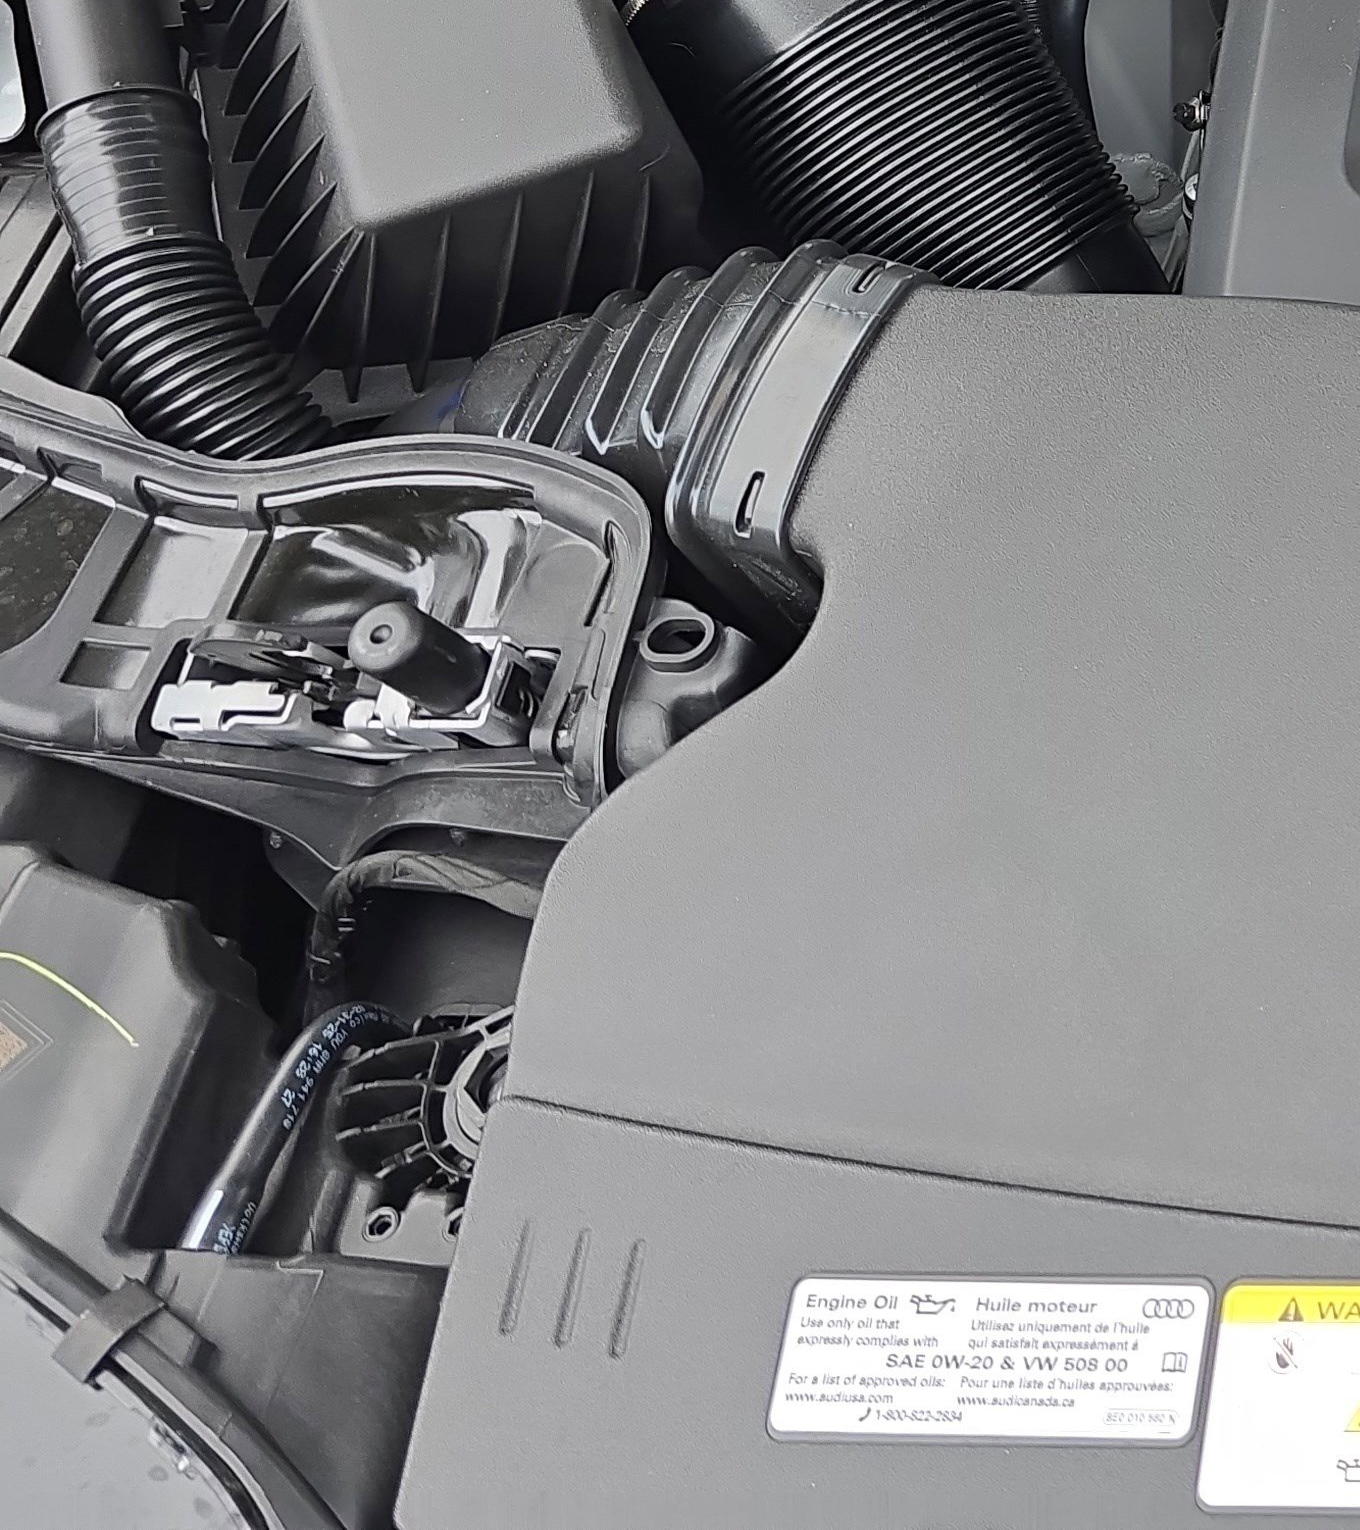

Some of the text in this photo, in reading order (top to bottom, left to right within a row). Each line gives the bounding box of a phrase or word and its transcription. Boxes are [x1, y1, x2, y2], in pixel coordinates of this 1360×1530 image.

[806, 1294, 898, 1311] Engine Oil
[976, 1297, 1098, 1313] Huile moteur
[800, 1317, 900, 1330] Use only oil that
[971, 1320, 1015, 1332] Utilisez
[1018, 1321, 1091, 1336] uniquement
[1094, 1322, 1109, 1333] de
[797, 1334, 939, 1349] expressly complies with
[968, 1338, 988, 1352] qui
[991, 1338, 1039, 1350] satisfait
[886, 1353, 1128, 1372] SAE 0W-20 & VW 508 00
[788, 1373, 946, 1388] For a list of approved oils:
[960, 1376, 988, 1389] Pour
[992, 1379, 1014, 1389] une
[1019, 1377, 1043, 1389] liste
[785, 1392, 893, 1404] www.audiusa.com
[957, 1396, 1075, 1408] www.audicanada.ca
